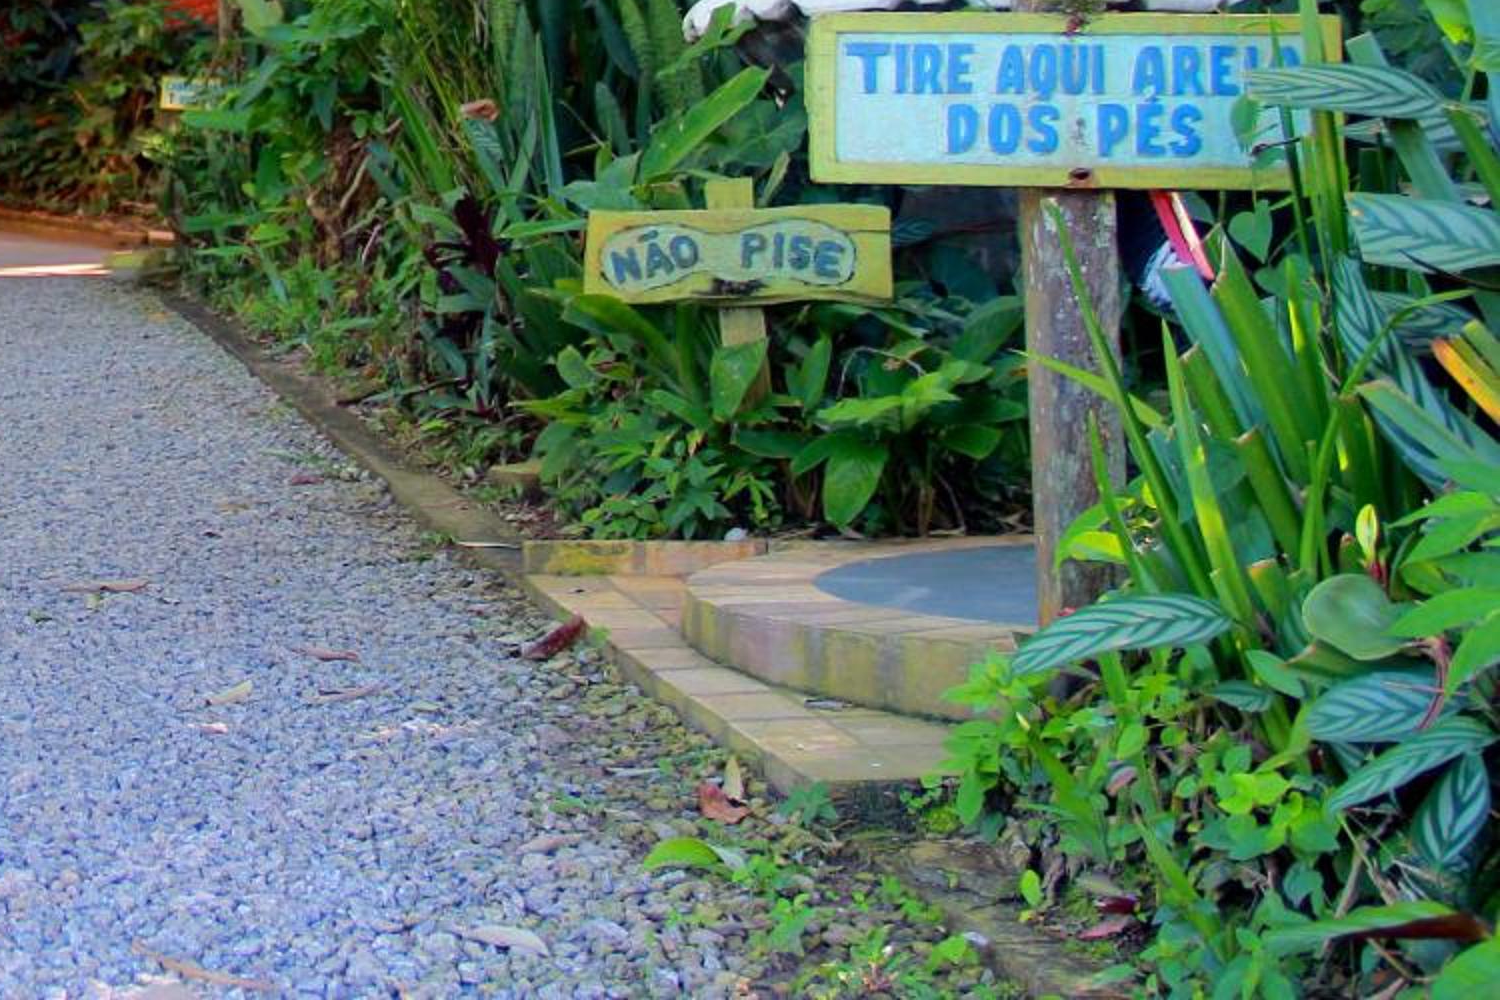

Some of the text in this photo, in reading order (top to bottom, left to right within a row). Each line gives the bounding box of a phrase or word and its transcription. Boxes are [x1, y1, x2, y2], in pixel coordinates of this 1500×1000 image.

[846, 42, 974, 95] TIRE
[998, 42, 1106, 100] AQUI
[947, 90, 1202, 156] DOS PÉS
[610, 230, 844, 284] NÃO PISE
